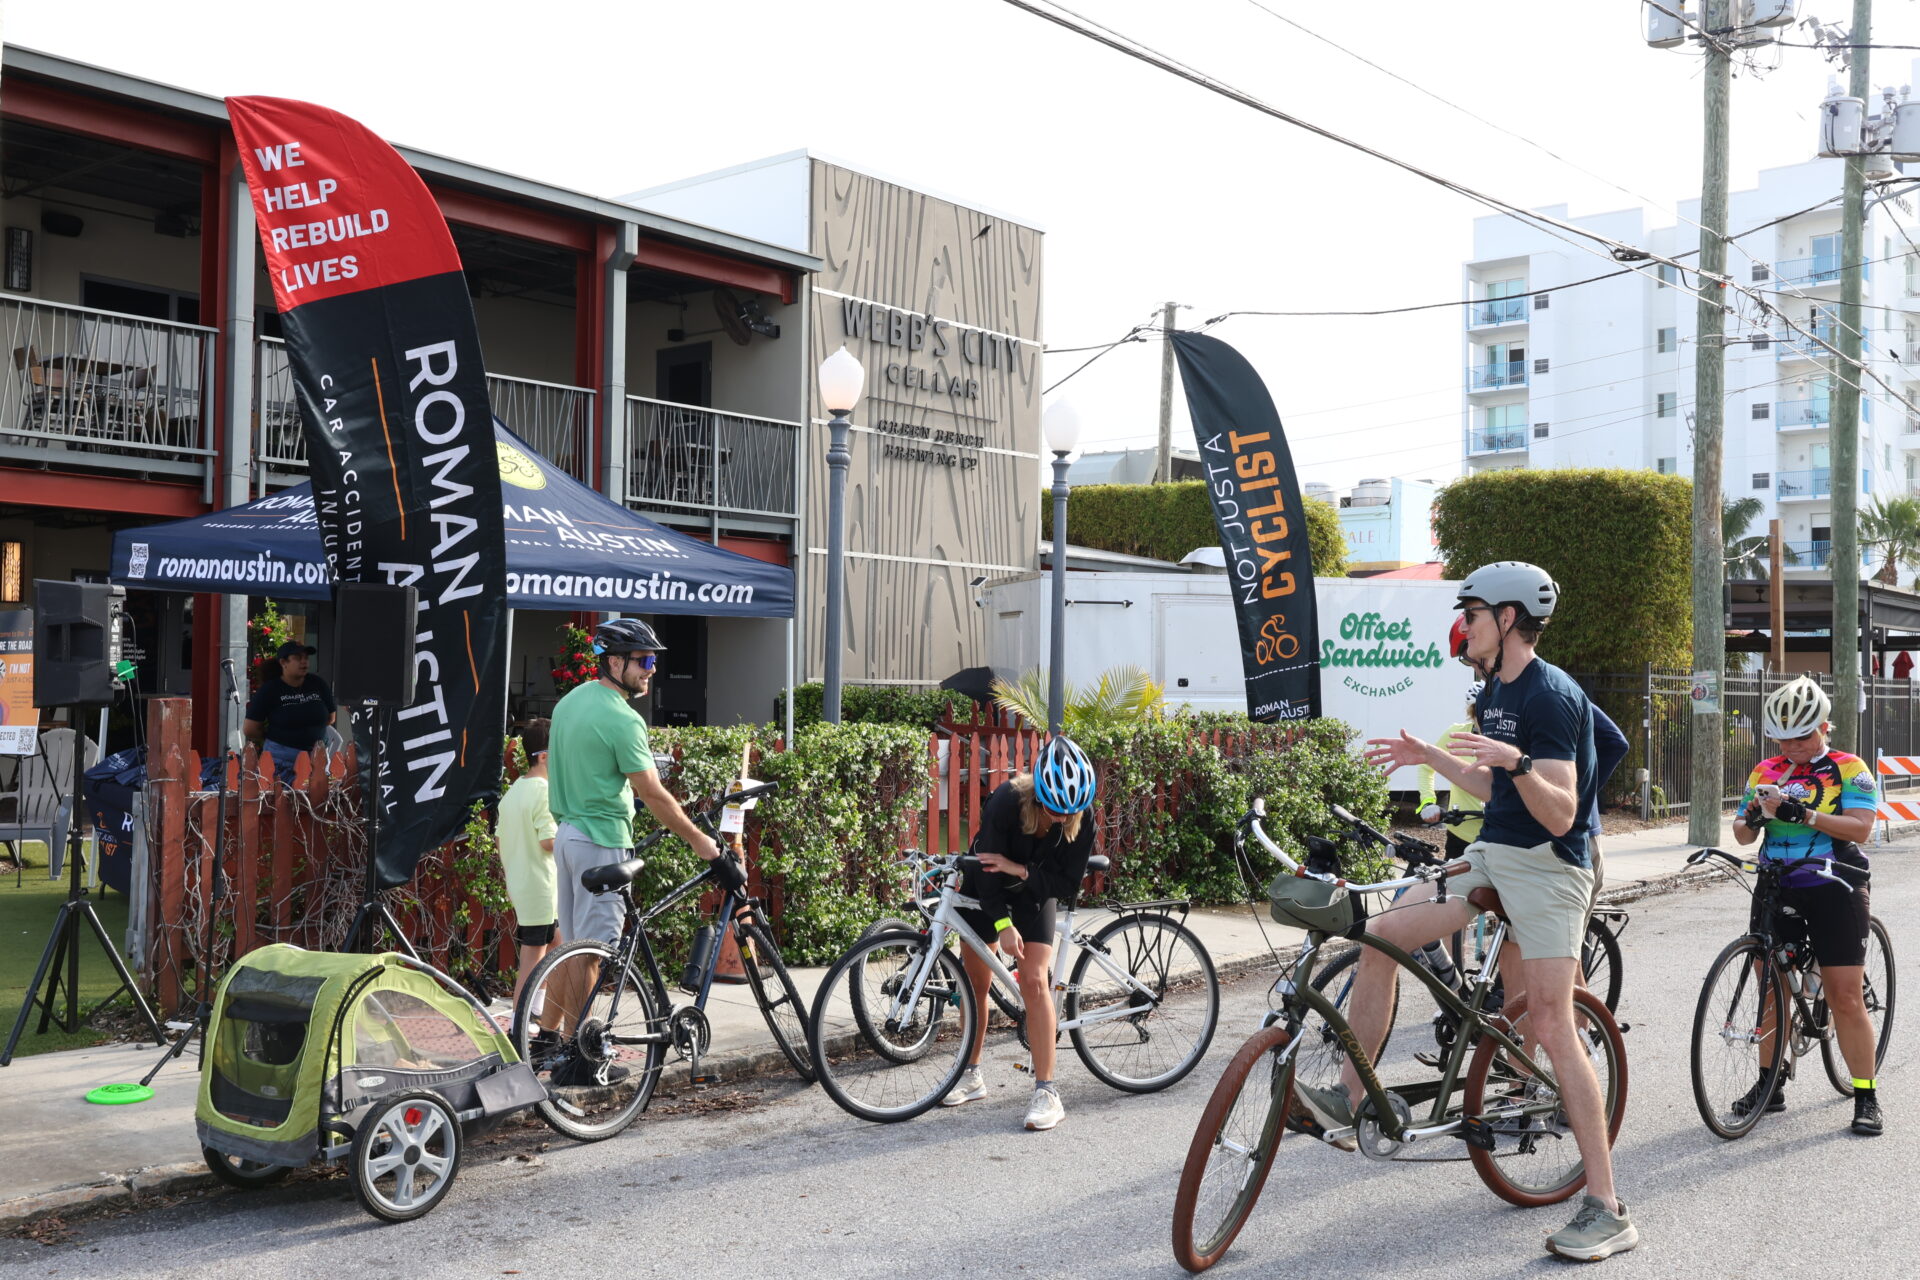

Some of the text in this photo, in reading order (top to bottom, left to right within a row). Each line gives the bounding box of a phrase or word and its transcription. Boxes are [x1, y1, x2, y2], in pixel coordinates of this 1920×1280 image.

[254, 141, 305, 172] WE
[263, 178, 338, 213] HELP
[271, 208, 389, 253] REBUILD
[281, 255, 359, 294] LIVES
[842, 297, 1021, 373] WEBB'S CITY
[887, 362, 980, 400] CELLAR
[877, 419, 985, 449] GREEN BENCH
[405, 340, 484, 606] ROMAN
[885, 444, 957, 468] BREWING
[320, 374, 344, 433] CAR
[339, 451, 362, 583] ACCIDENT
[1204, 432, 1259, 605] NOT JUST A
[1229, 430, 1297, 600] CYCLIST
[557, 526, 680, 553] AUSTIN
[506, 571, 754, 604] omanaustin.com
[1339, 612, 1413, 641] Offset
[1320, 638, 1444, 669] Sandwich
[1343, 675, 1414, 698] EXCHANGE
[1255, 699, 1290, 717] ROMAN
